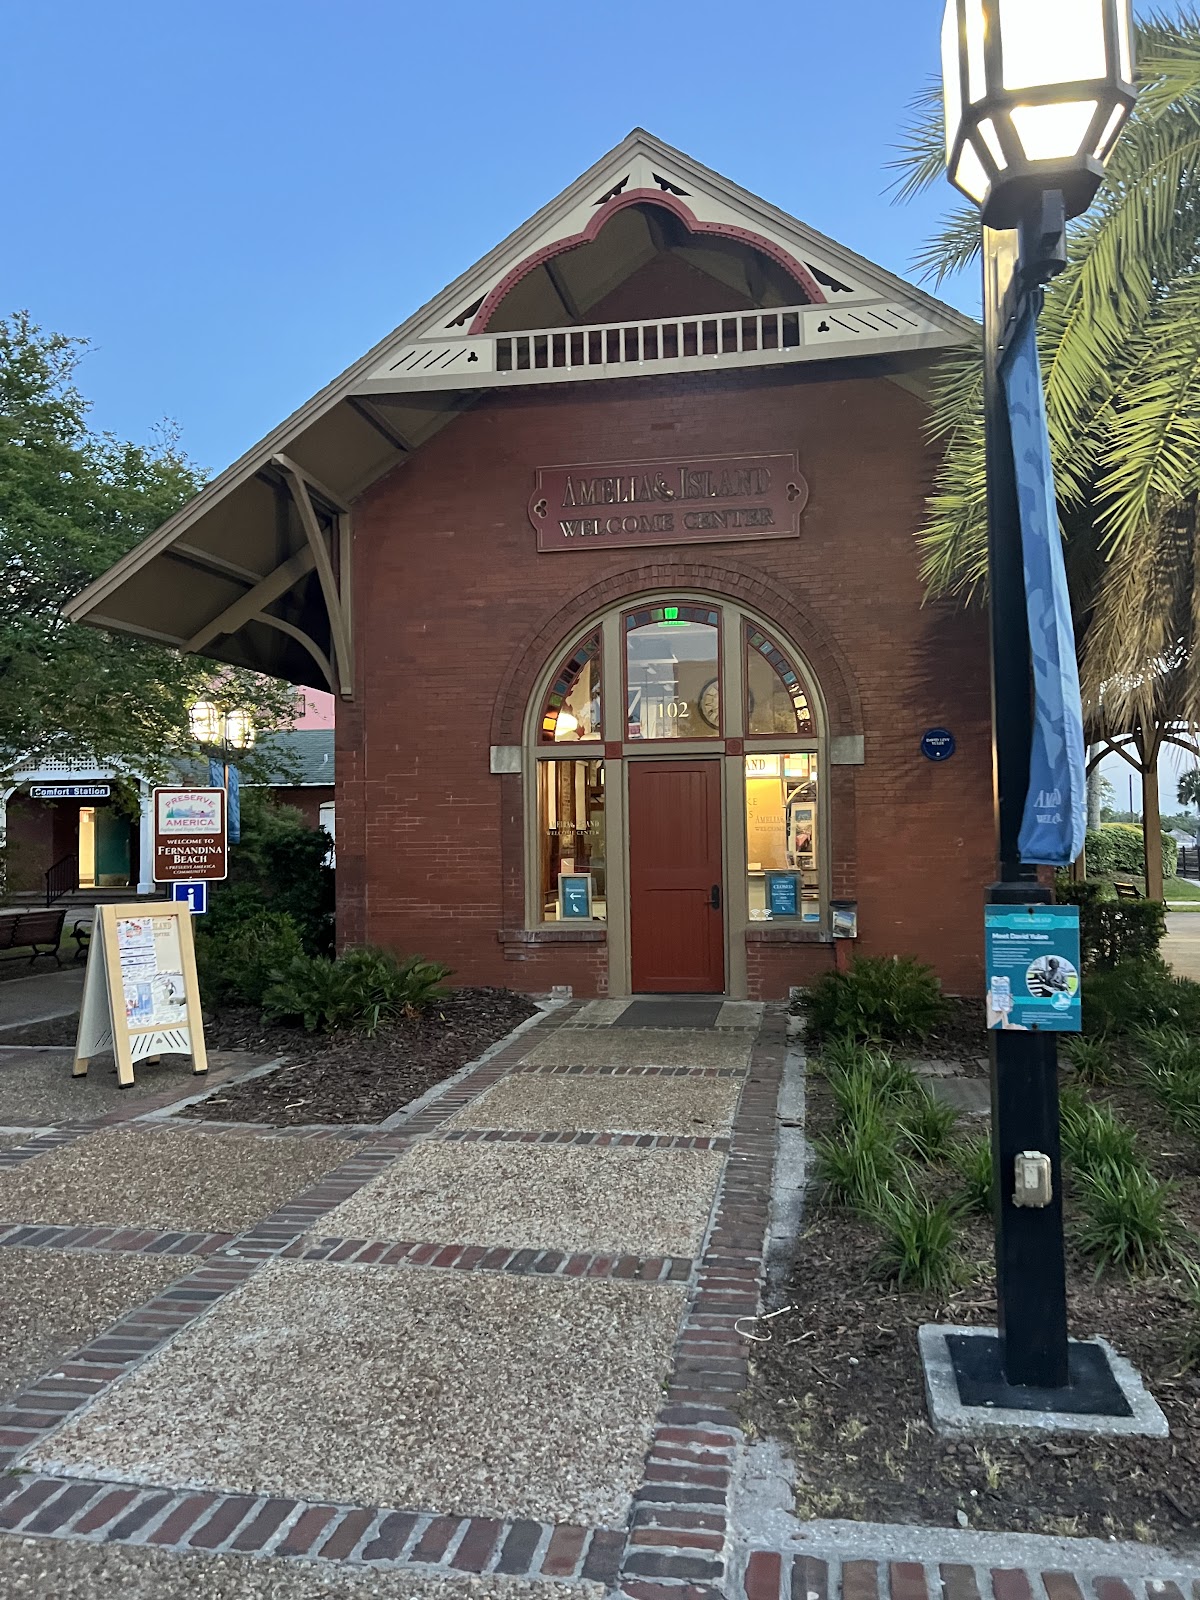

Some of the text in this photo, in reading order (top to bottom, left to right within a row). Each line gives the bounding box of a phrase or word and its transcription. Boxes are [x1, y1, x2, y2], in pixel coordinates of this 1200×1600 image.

[561, 475, 651, 507] AMELIA
[677, 466, 772, 499] ISLAND
[559, 507, 776, 537] WELCOME CENTER
[658, 702, 690, 718] 102
[34, 786, 106, 796] Comfort Station
[165, 794, 216, 808] PRESERVE
[158, 846, 222, 856] FERNANDINA
[173, 854, 207, 864] BEACH
